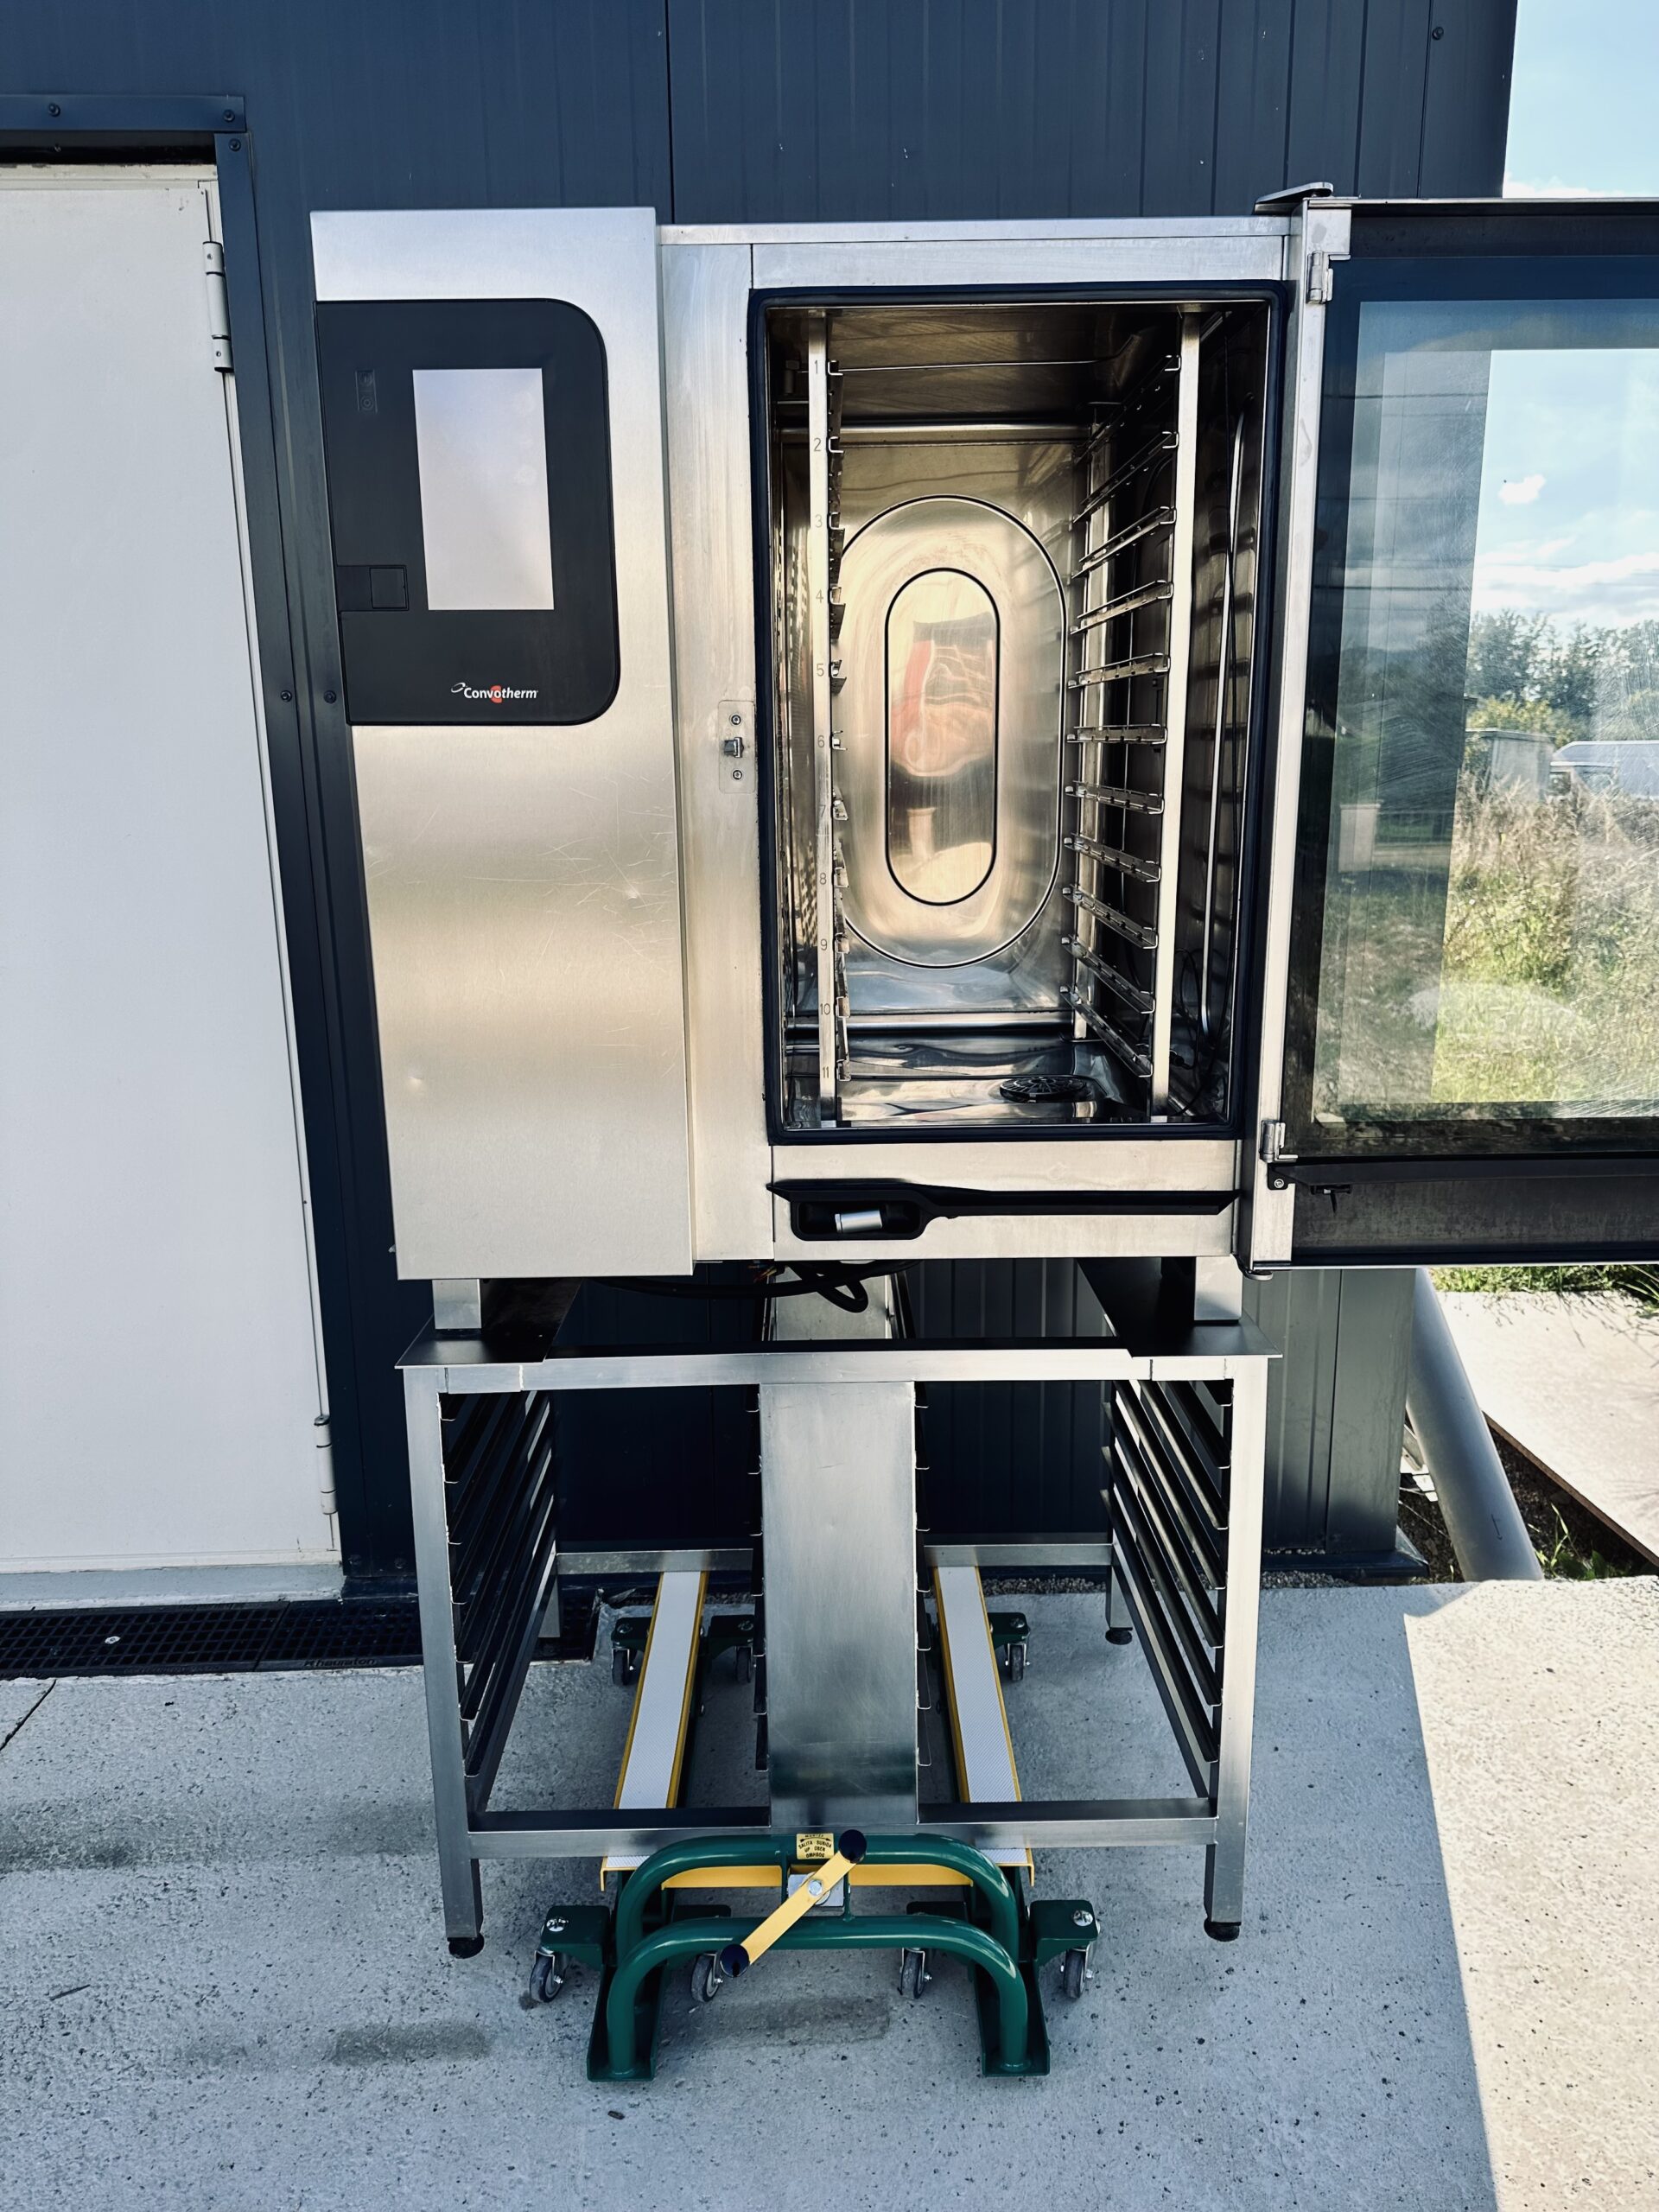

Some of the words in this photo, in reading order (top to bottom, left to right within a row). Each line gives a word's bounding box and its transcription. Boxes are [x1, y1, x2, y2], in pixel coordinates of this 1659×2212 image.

[814, 360, 818, 373] 1
[814, 437, 822, 452] 2
[815, 514, 823, 528] 3
[815, 589, 824, 603] 4
[816, 663, 824, 677] 5
[464, 687, 537, 698] Convotherm
[817, 734, 825, 748] 6
[819, 804, 827, 817] 7
[819, 873, 827, 885] 8
[820, 938, 828, 950] 9
[820, 1003, 831, 1015] 10
